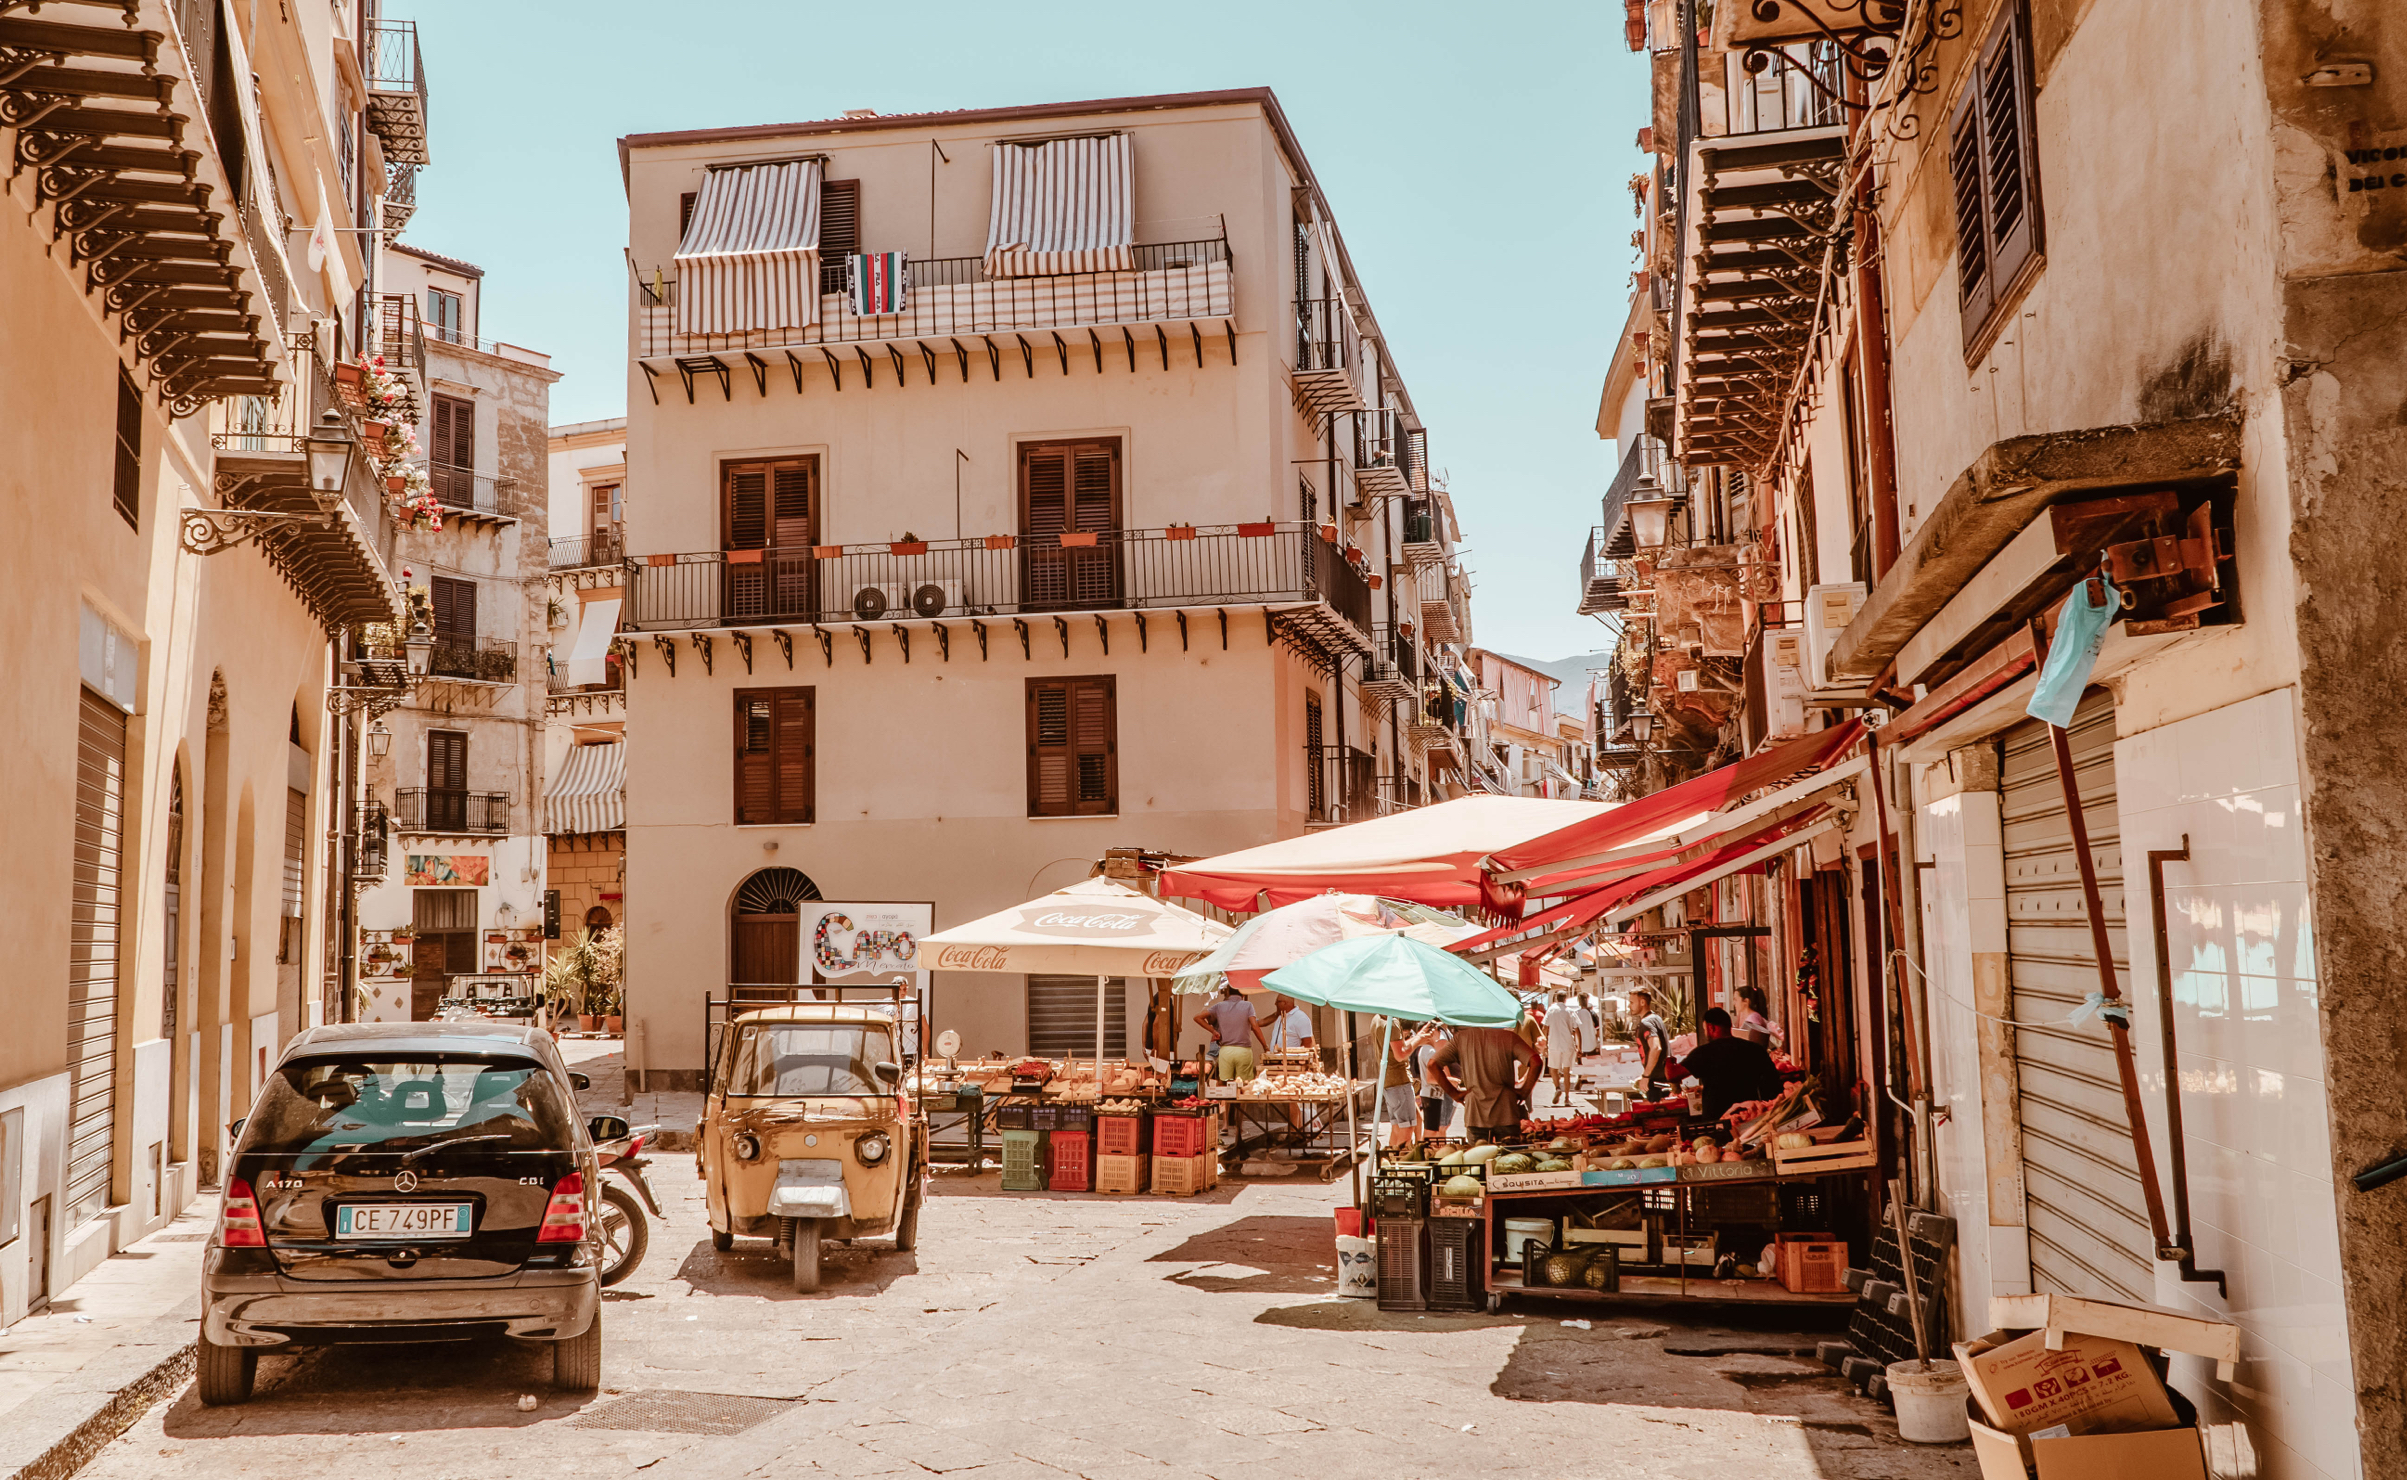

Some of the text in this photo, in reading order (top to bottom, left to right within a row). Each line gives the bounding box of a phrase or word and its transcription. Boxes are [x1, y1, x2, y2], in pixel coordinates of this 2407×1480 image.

[2348, 176, 2385, 192] DEI
[857, 960, 915, 972] Mercato
[1698, 1165, 1752, 1178] Vittoria
[266, 1176, 544, 1189] A170 CDI
[355, 1209, 380, 1231] CE
[388, 1208, 455, 1231] 749PF
[2014, 1402, 2048, 1420] 180GM
[2050, 1398, 2057, 1407] X
[2058, 1386, 2089, 1403] 40PCS
[2098, 1377, 2113, 1388] 7.2
[2114, 1371, 2133, 1383] KG.
